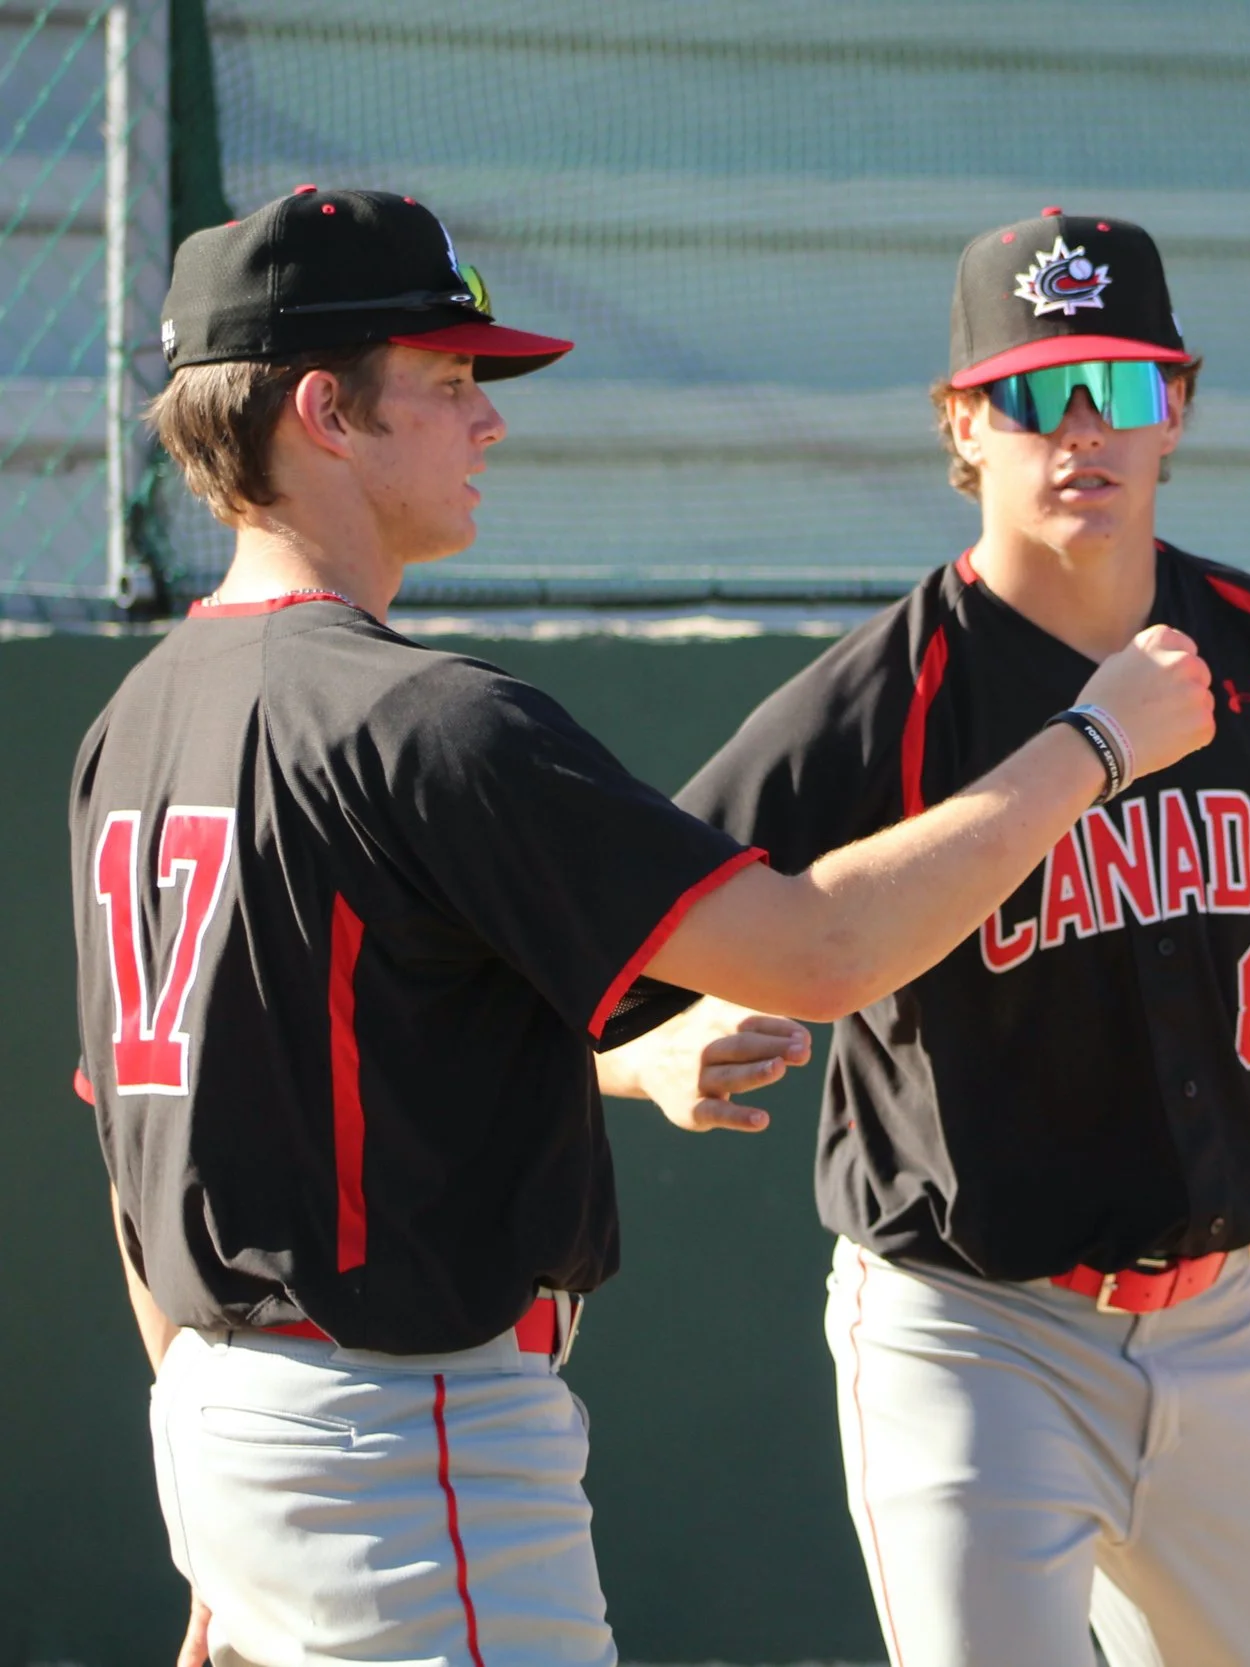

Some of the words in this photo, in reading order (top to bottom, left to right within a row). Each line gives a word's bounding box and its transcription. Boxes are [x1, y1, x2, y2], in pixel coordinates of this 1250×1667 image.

[1084, 725, 1107, 749] FORTY
[1103, 750, 1119, 778] SEVEN
[94, 805, 237, 1096] 17
